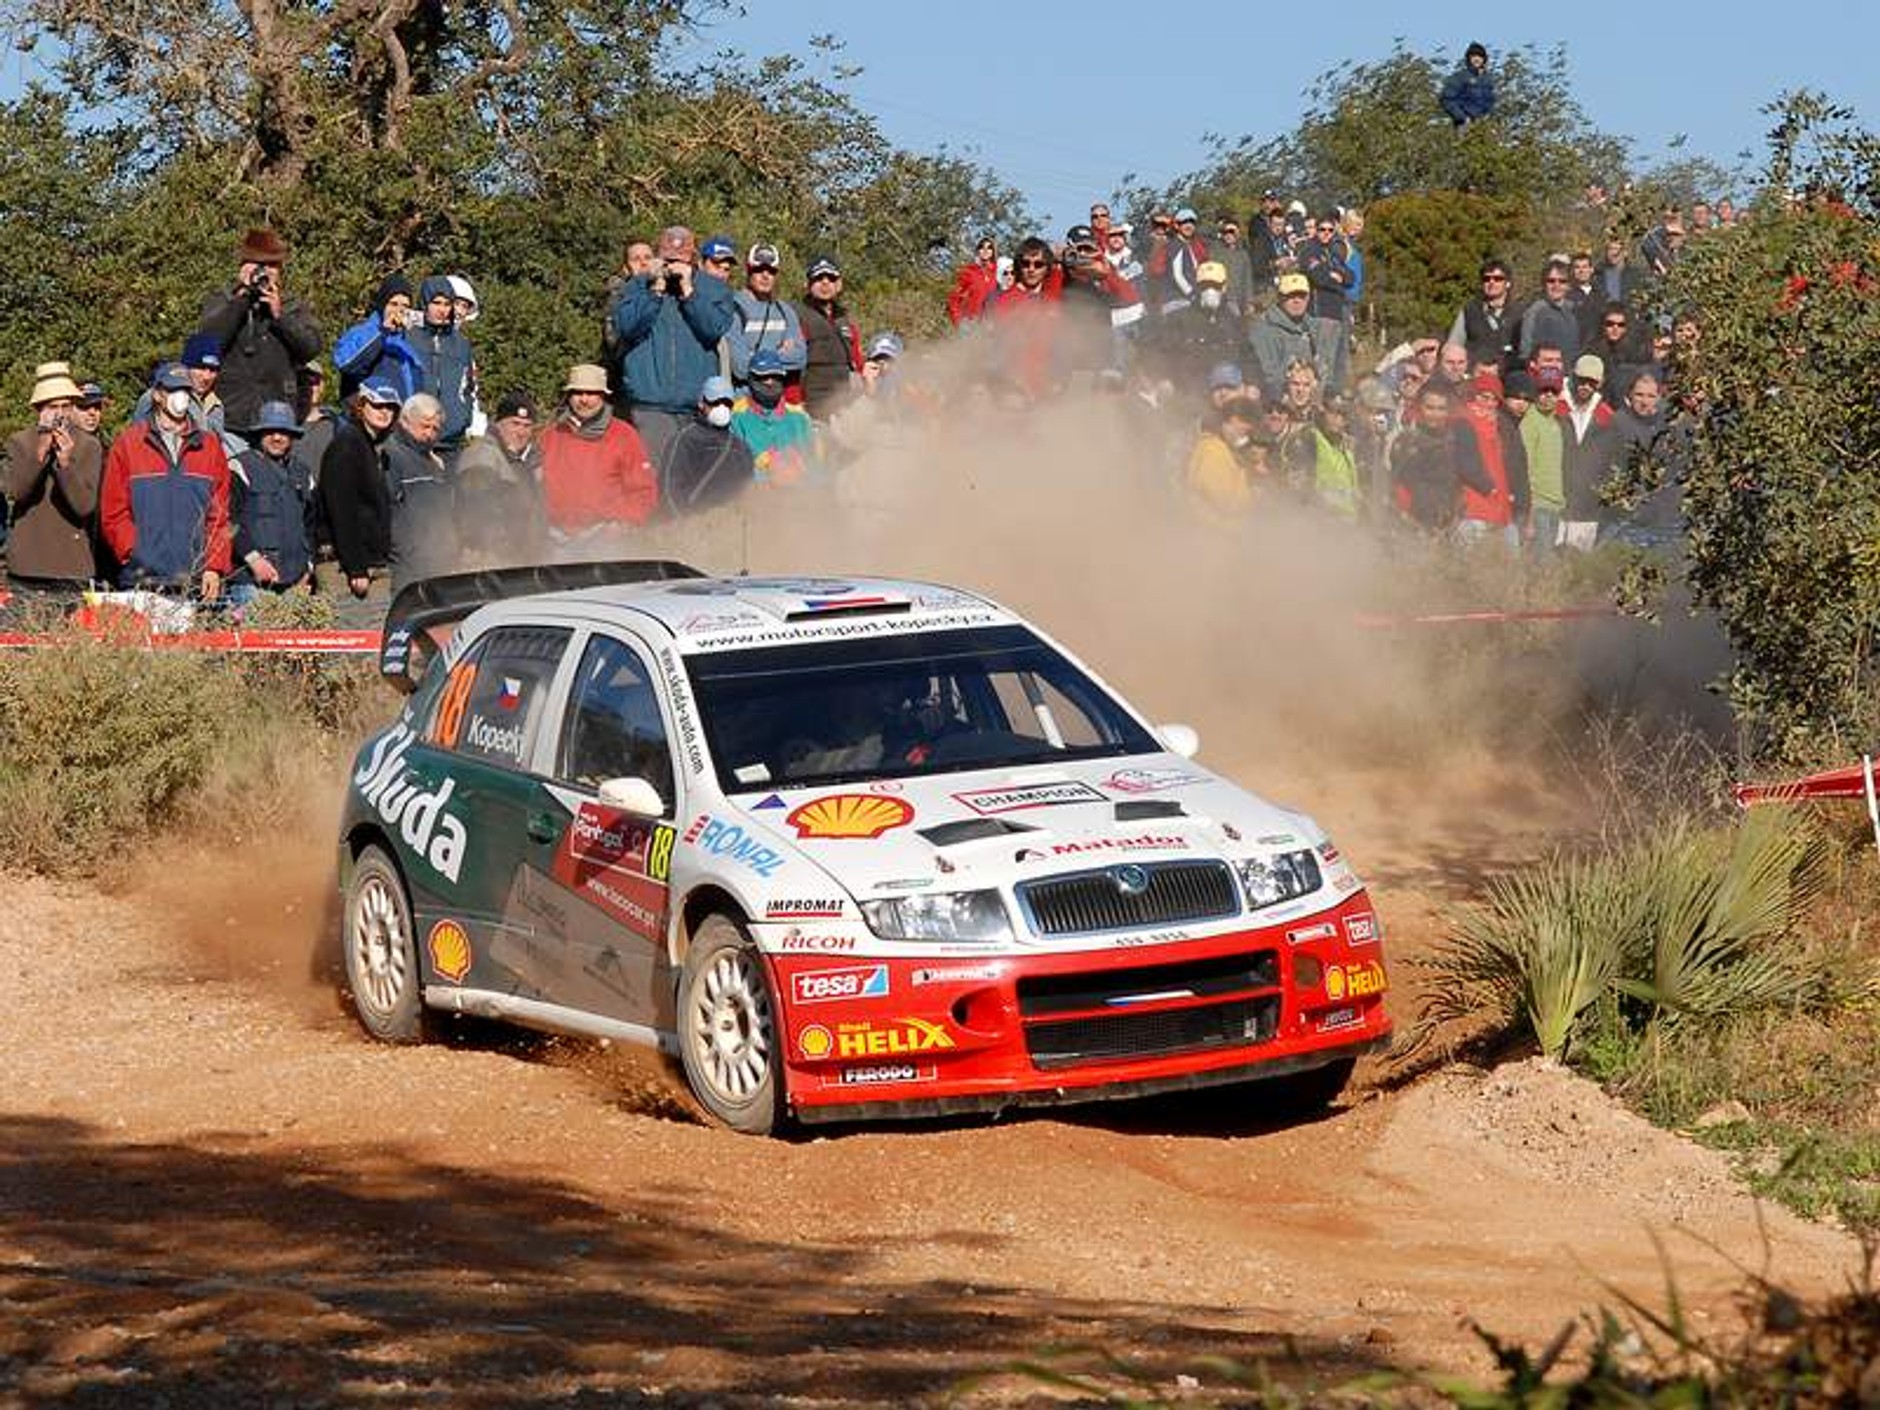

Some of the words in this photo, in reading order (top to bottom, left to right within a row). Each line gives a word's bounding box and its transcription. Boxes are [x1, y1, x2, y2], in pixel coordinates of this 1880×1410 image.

[436, 663, 477, 748] 18
[974, 786, 1092, 807] CHAMPION
[651, 826, 673, 879] 18
[1051, 834, 1186, 854] Matador
[766, 899, 844, 912] IMPROMAT
[782, 935, 856, 950] RICOH
[798, 974, 859, 998] tesa
[838, 1017, 955, 1056] HELIX
[845, 1065, 914, 1082] FERODO
